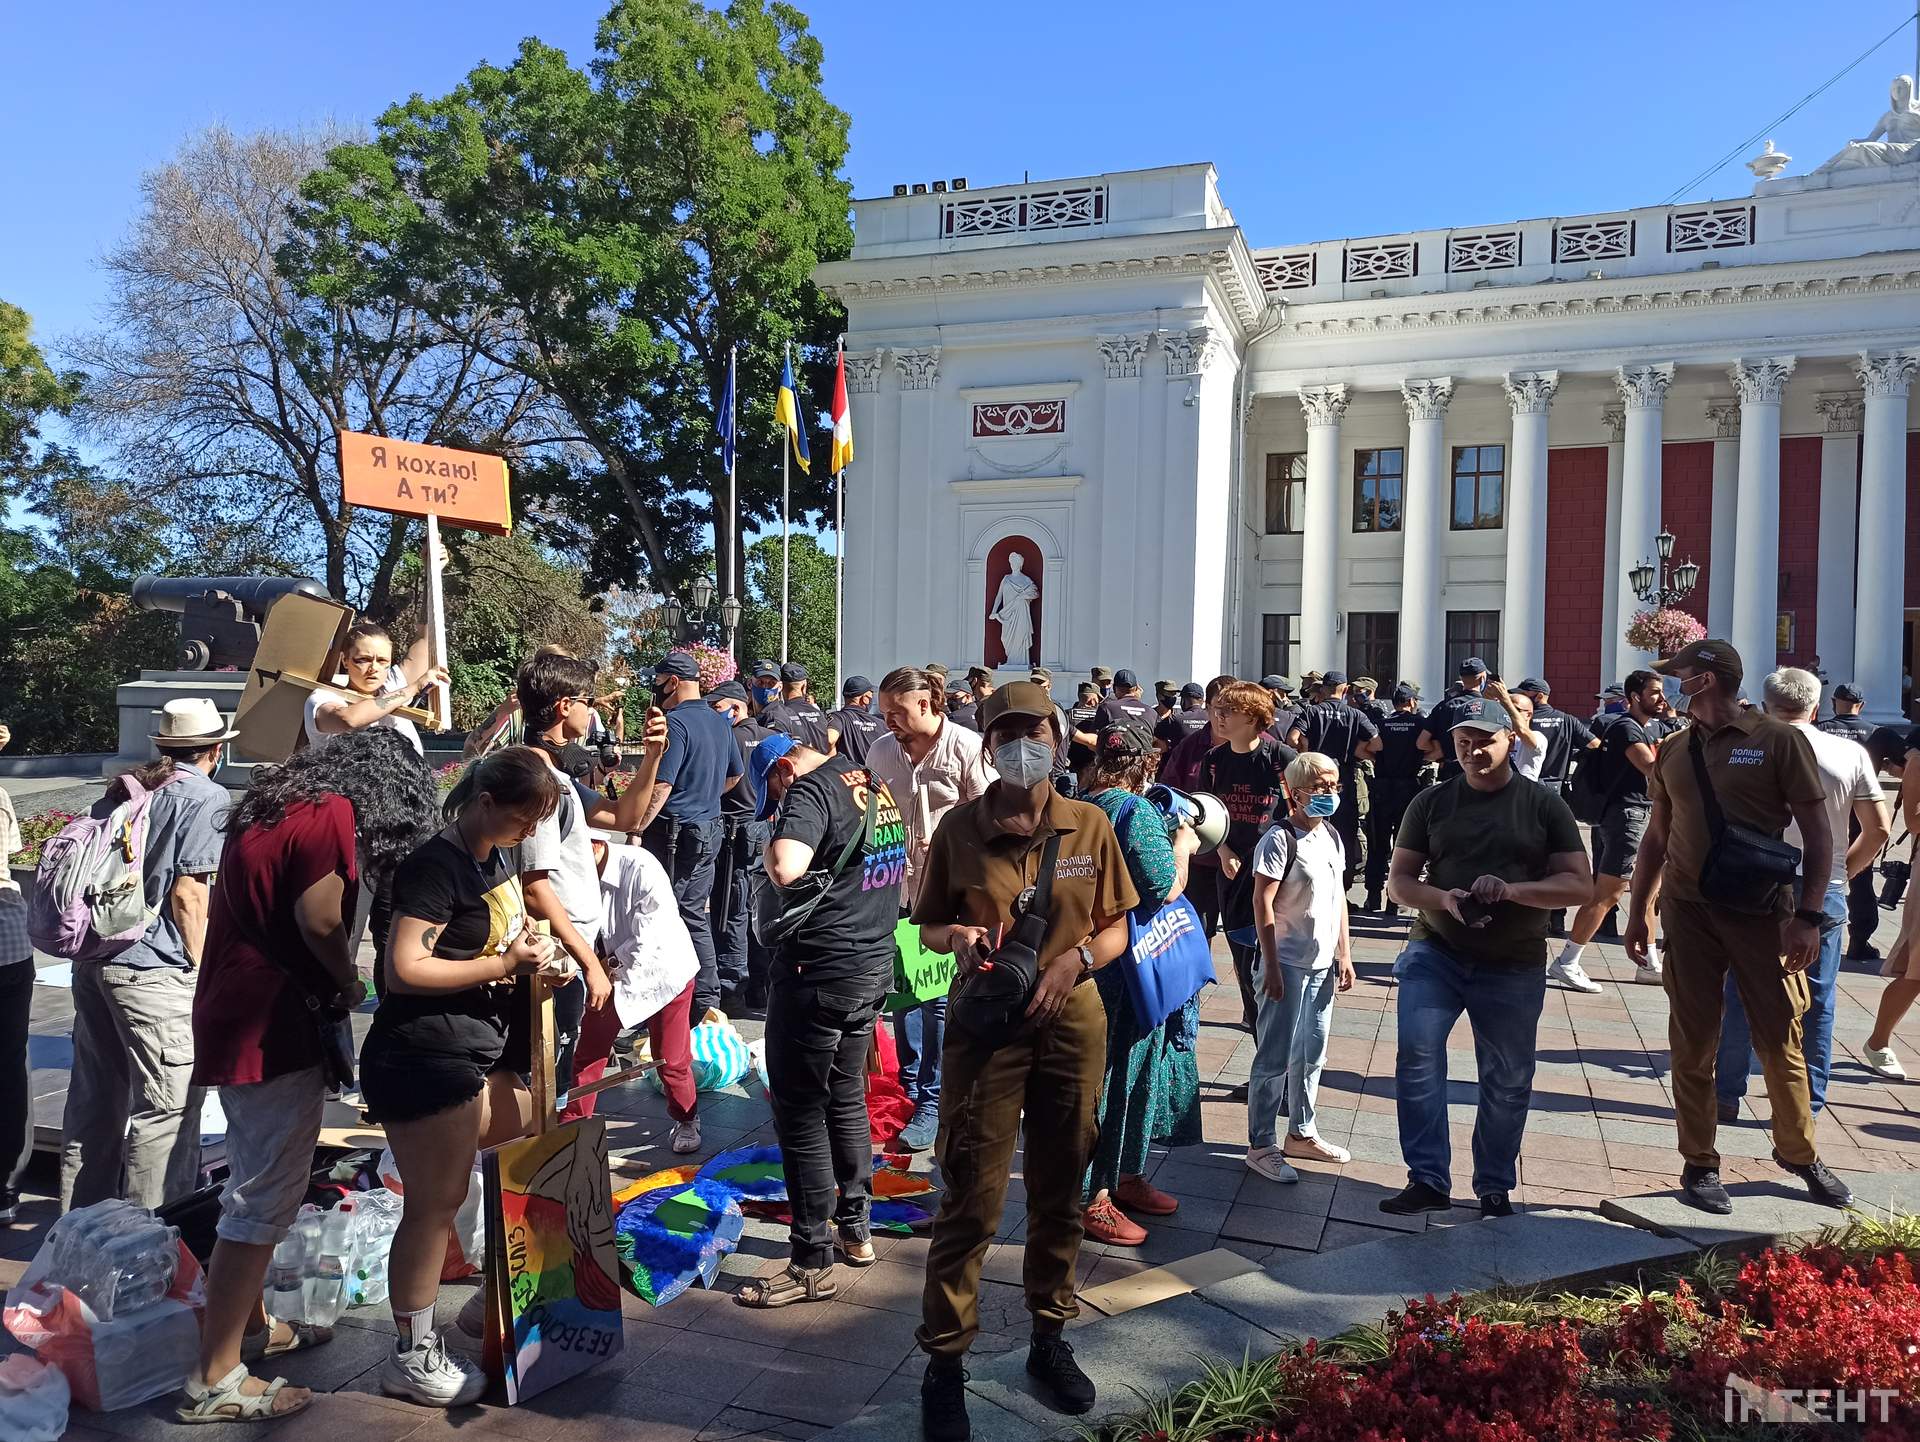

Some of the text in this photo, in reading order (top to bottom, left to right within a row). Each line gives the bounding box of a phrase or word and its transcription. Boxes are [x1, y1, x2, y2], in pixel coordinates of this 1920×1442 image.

[371, 446, 478, 481] Я кохаю!
[397, 477, 459, 505] А ти?
[1731, 748, 1764, 757] ПОЛІЦІЯ
[1728, 756, 1764, 766] ДІАЛОГУ
[1232, 784, 1251, 793] THE
[1219, 793, 1273, 805] EVOLUTION
[1055, 854, 1093, 867] ПОЛІЦІЯ
[1056, 866, 1095, 880] ДІАЛОГУ
[1132, 907, 1192, 965] meibes
